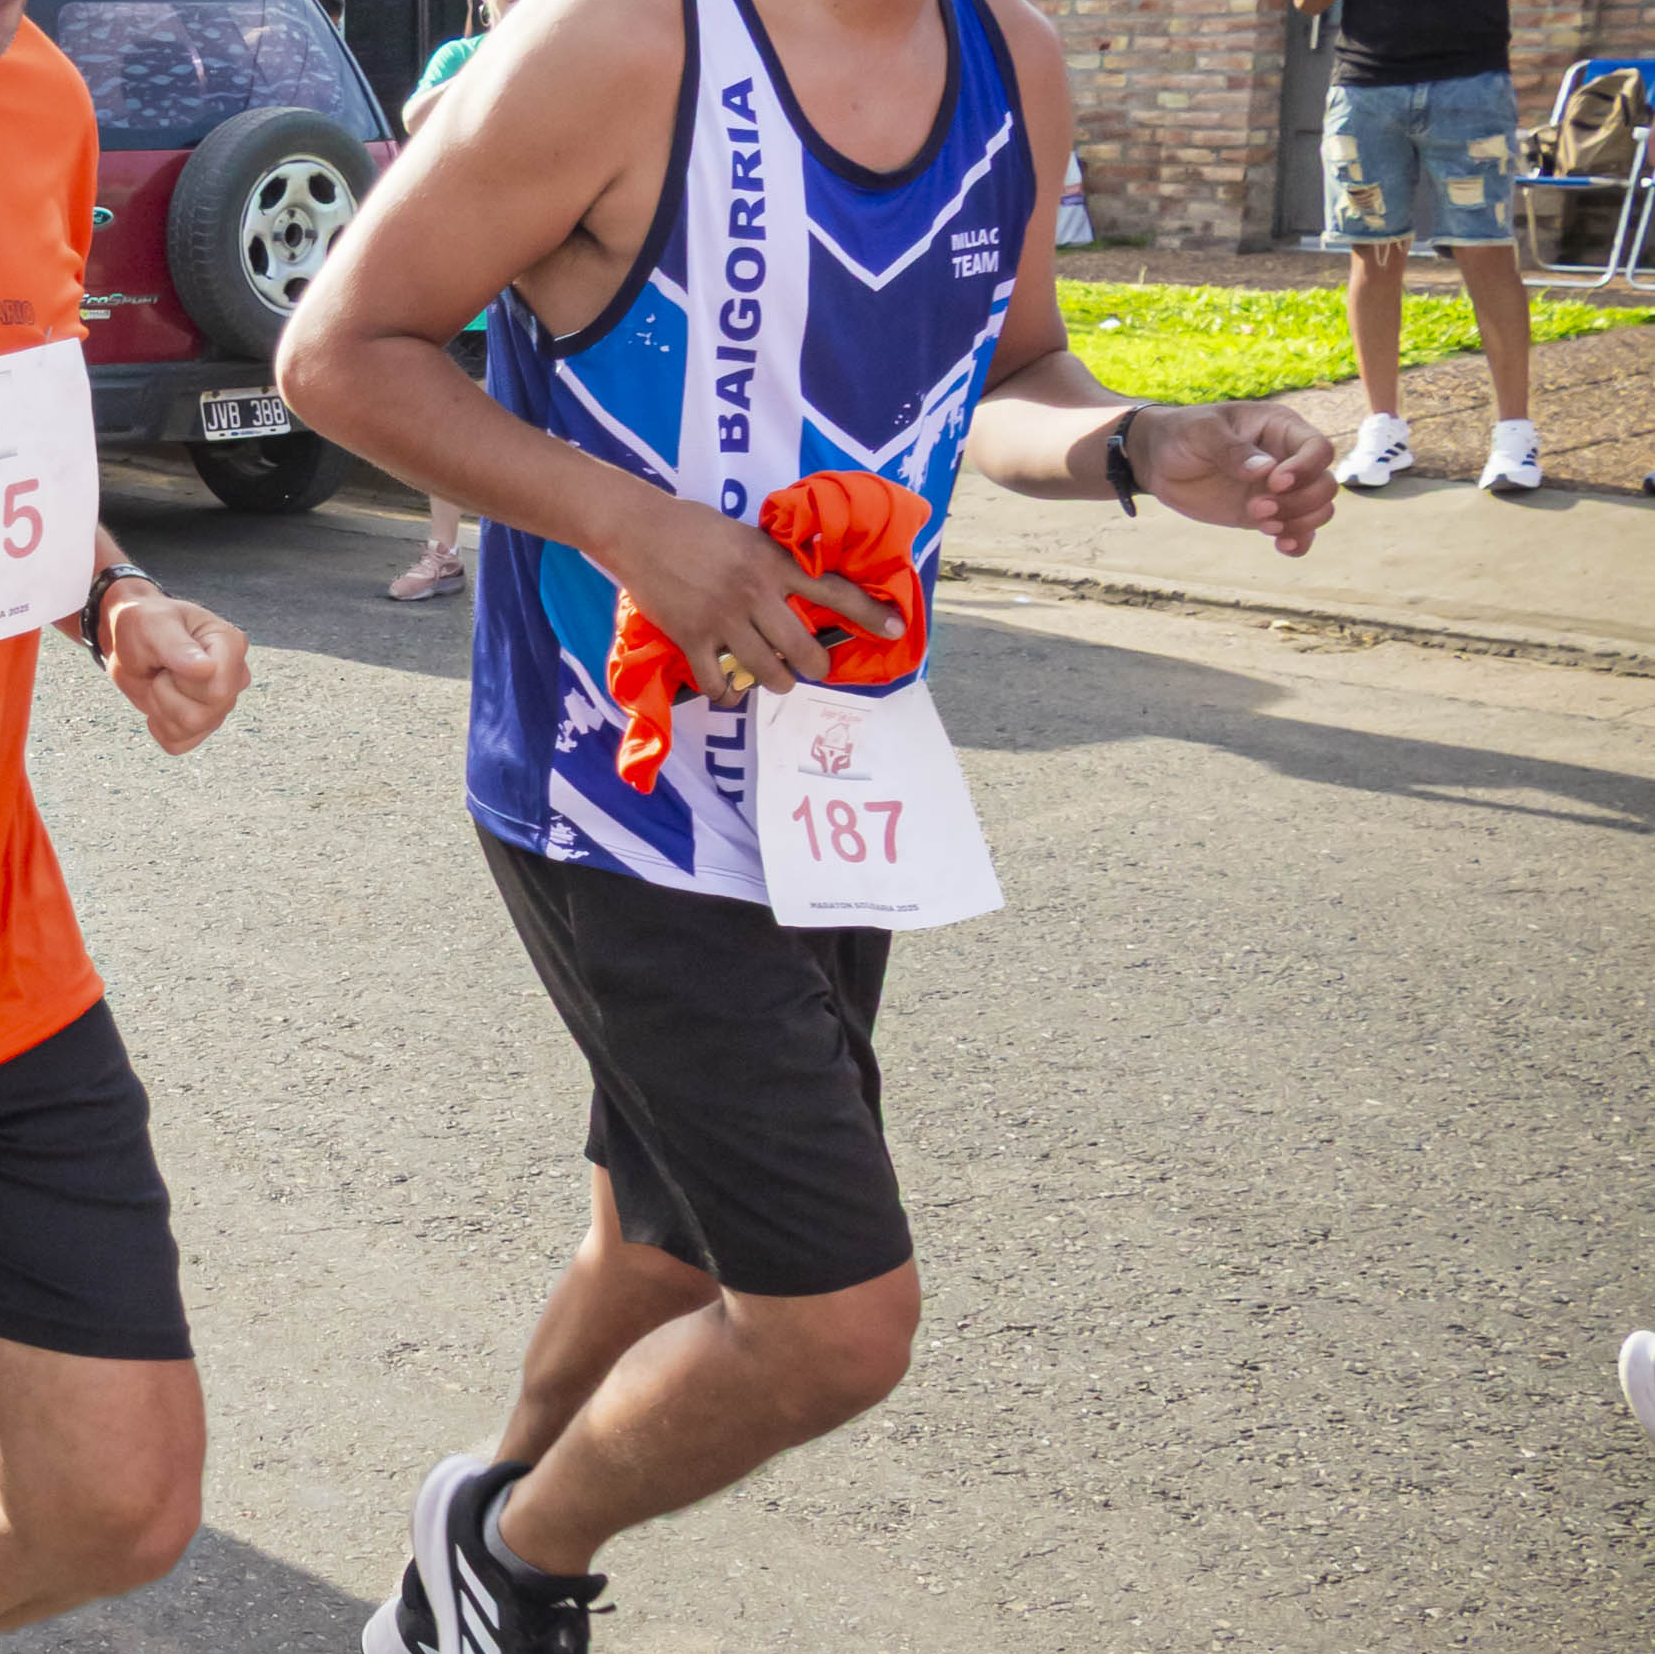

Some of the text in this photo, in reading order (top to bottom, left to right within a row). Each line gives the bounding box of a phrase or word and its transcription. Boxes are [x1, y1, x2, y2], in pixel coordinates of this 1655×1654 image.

[715, 76, 767, 454] BAIGORRIA
[951, 250, 1001, 279] TEAM
[207, 398, 285, 430] JVB 388
[7, 602, 31, 618] 2025
[792, 795, 903, 865] 187
